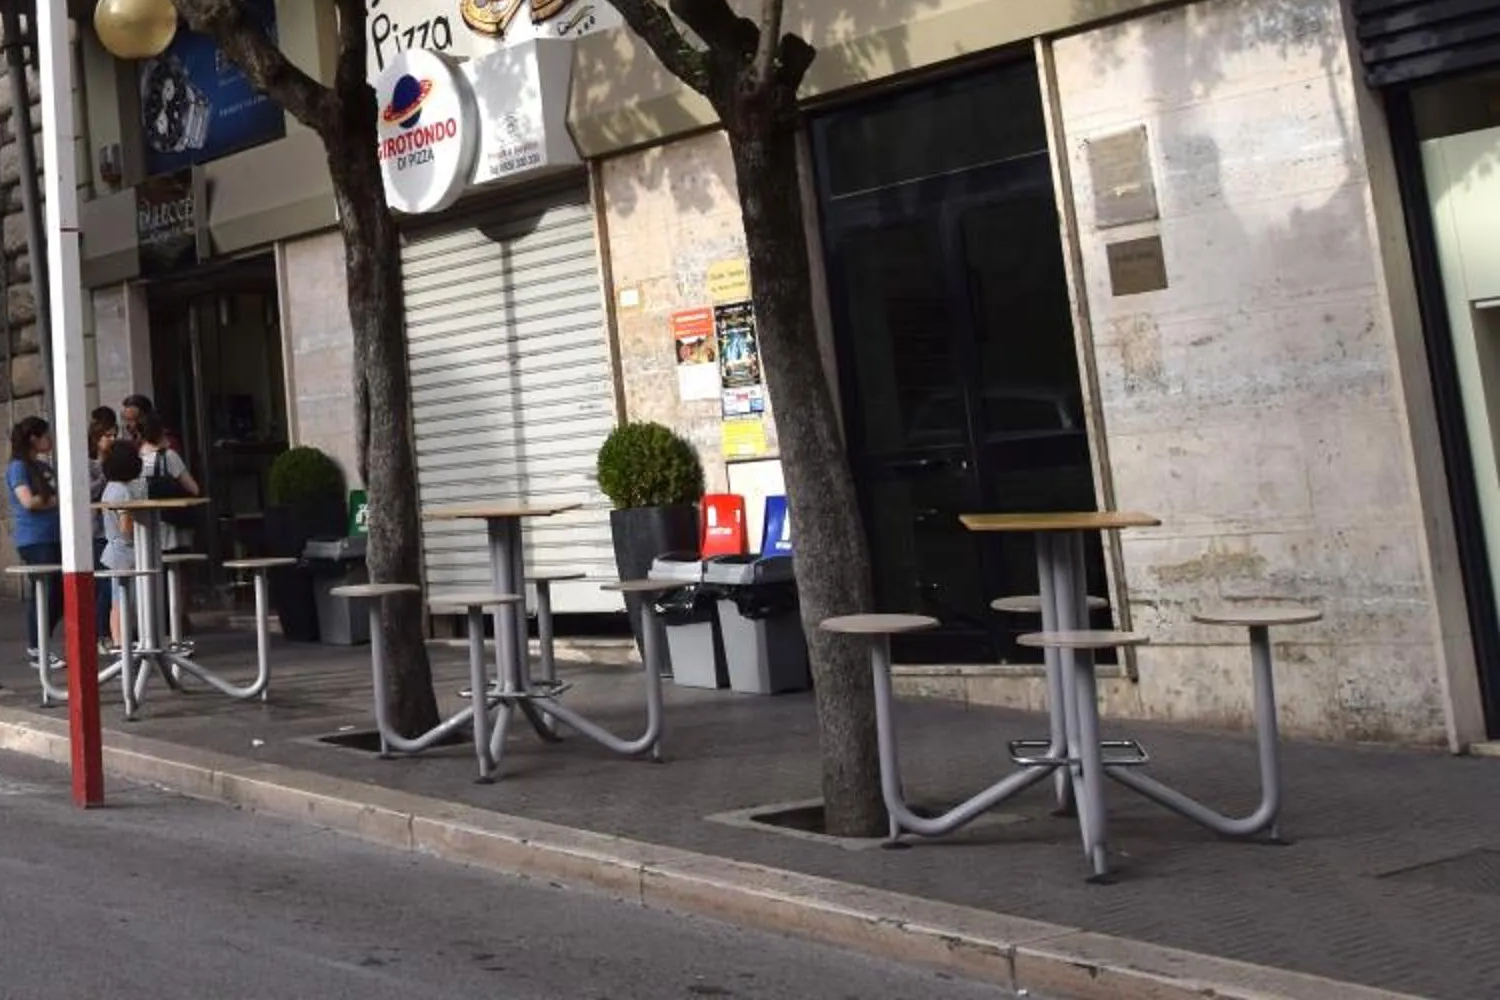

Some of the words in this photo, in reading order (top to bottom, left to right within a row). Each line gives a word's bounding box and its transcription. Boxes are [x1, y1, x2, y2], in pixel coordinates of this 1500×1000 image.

[372, 13, 453, 72] Pizza
[397, 156, 407, 171] DI
[408, 147, 435, 168] PIZZA
